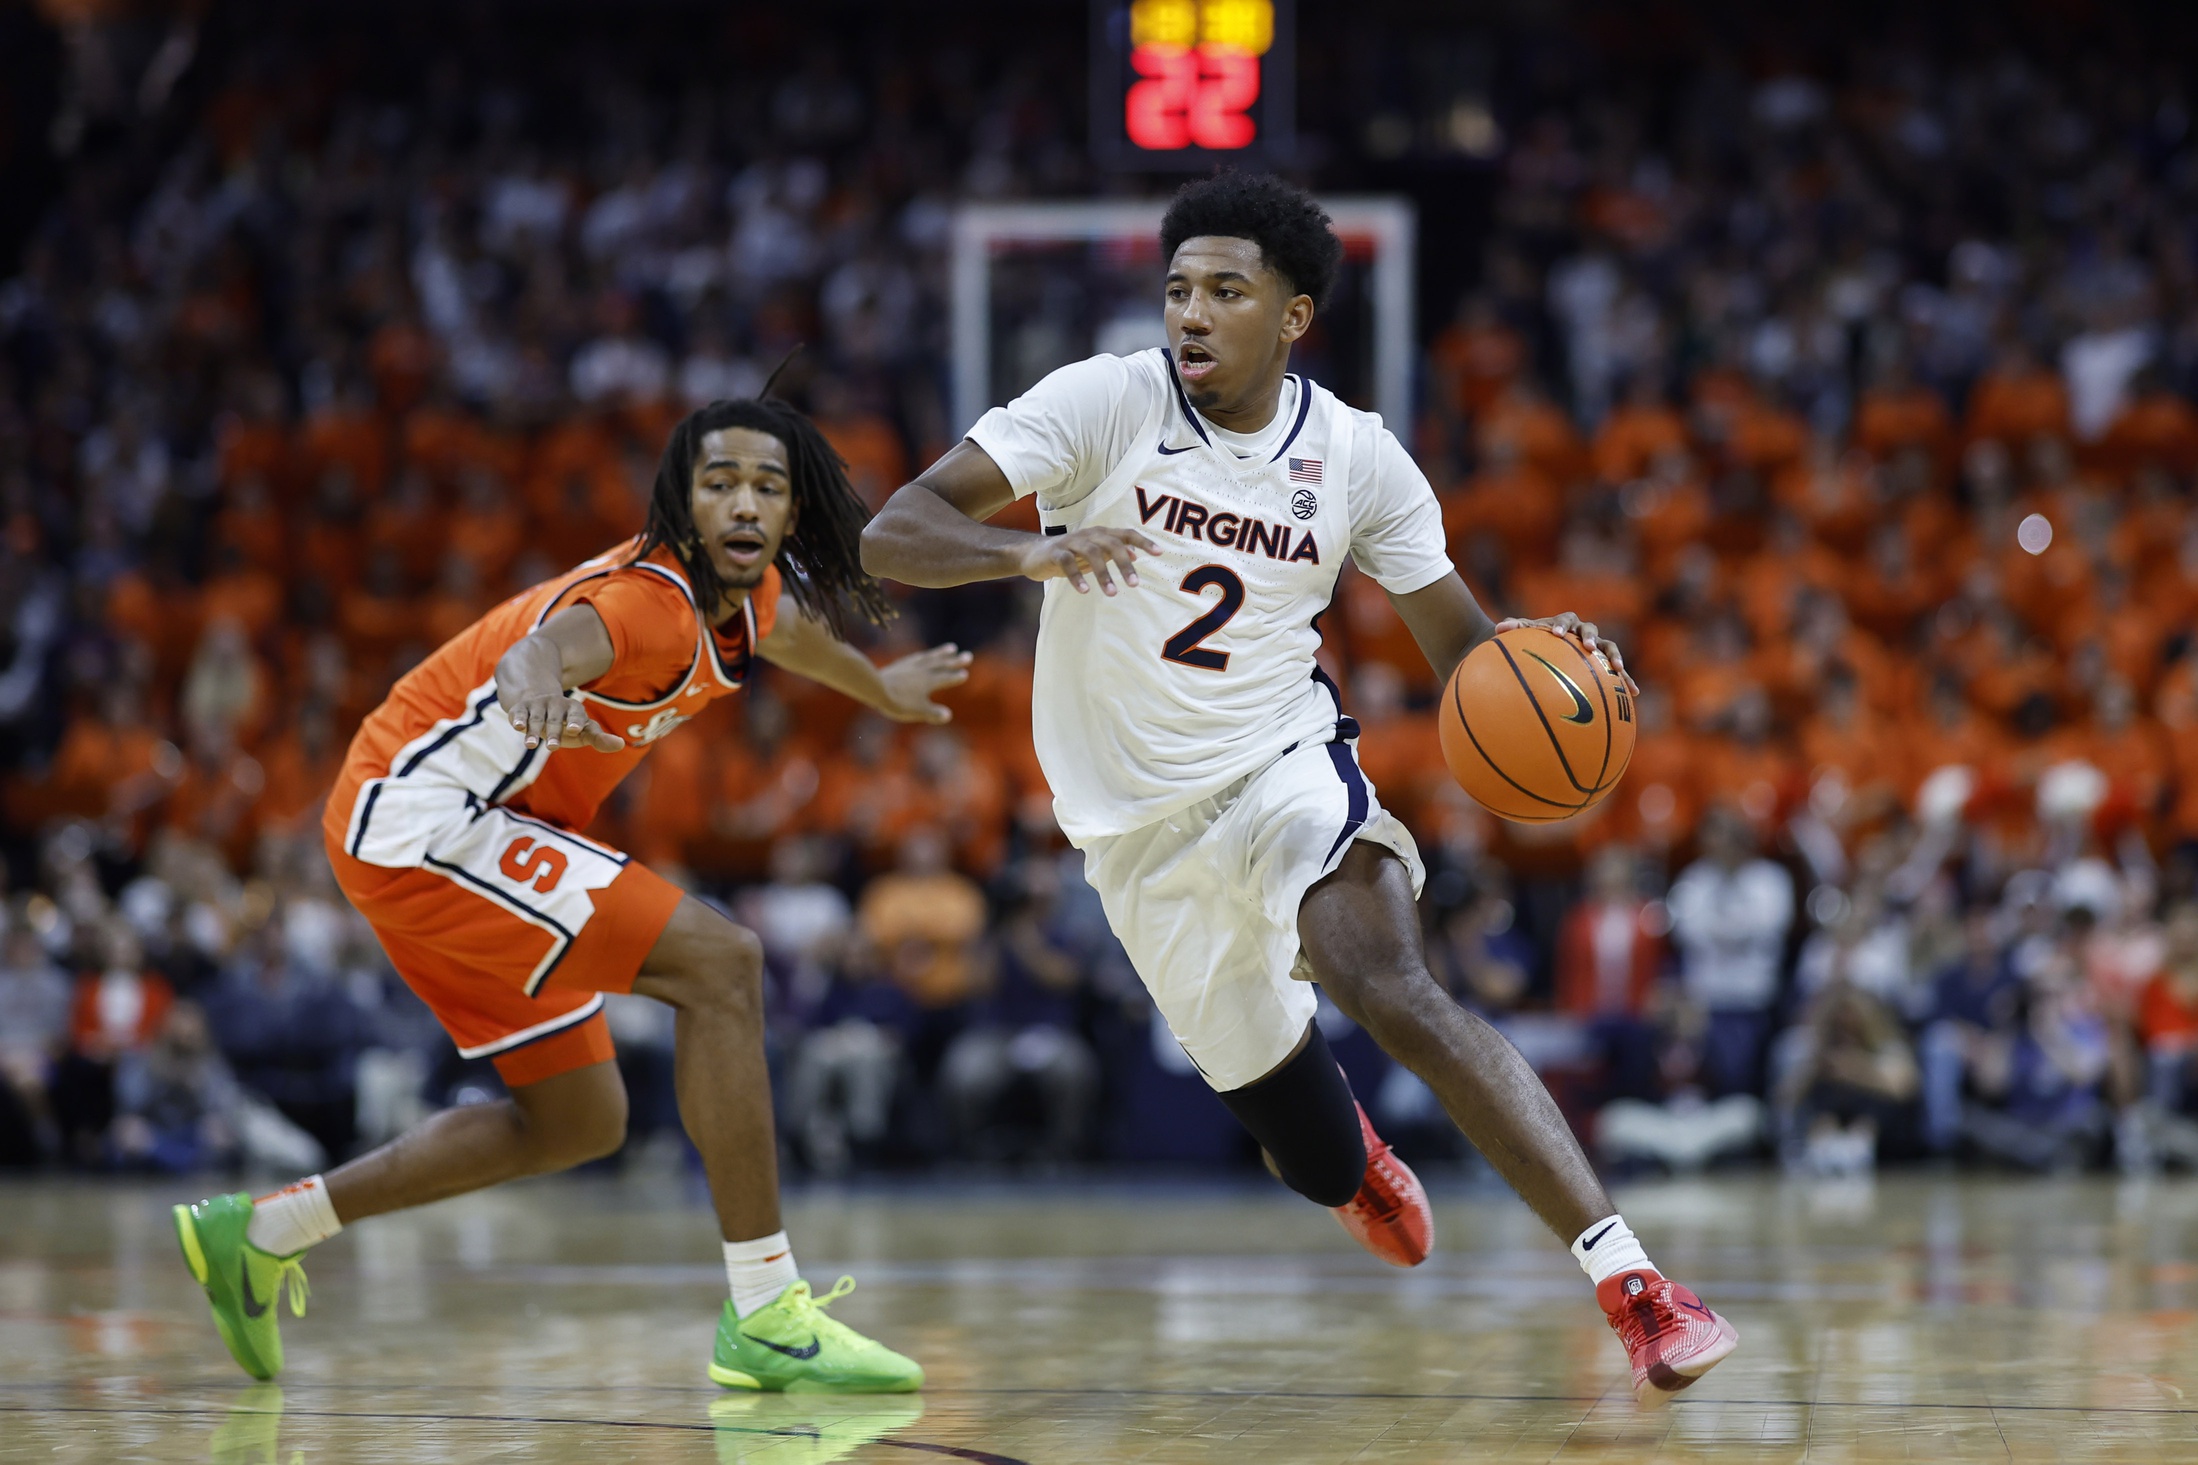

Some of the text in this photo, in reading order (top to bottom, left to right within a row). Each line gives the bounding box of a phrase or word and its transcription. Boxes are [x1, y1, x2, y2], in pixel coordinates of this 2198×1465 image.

[1134, 485, 1319, 565] VIRGINIA
[1293, 499, 1316, 510] ACC
[1160, 563, 1246, 672] 2
[499, 836, 568, 893] S
